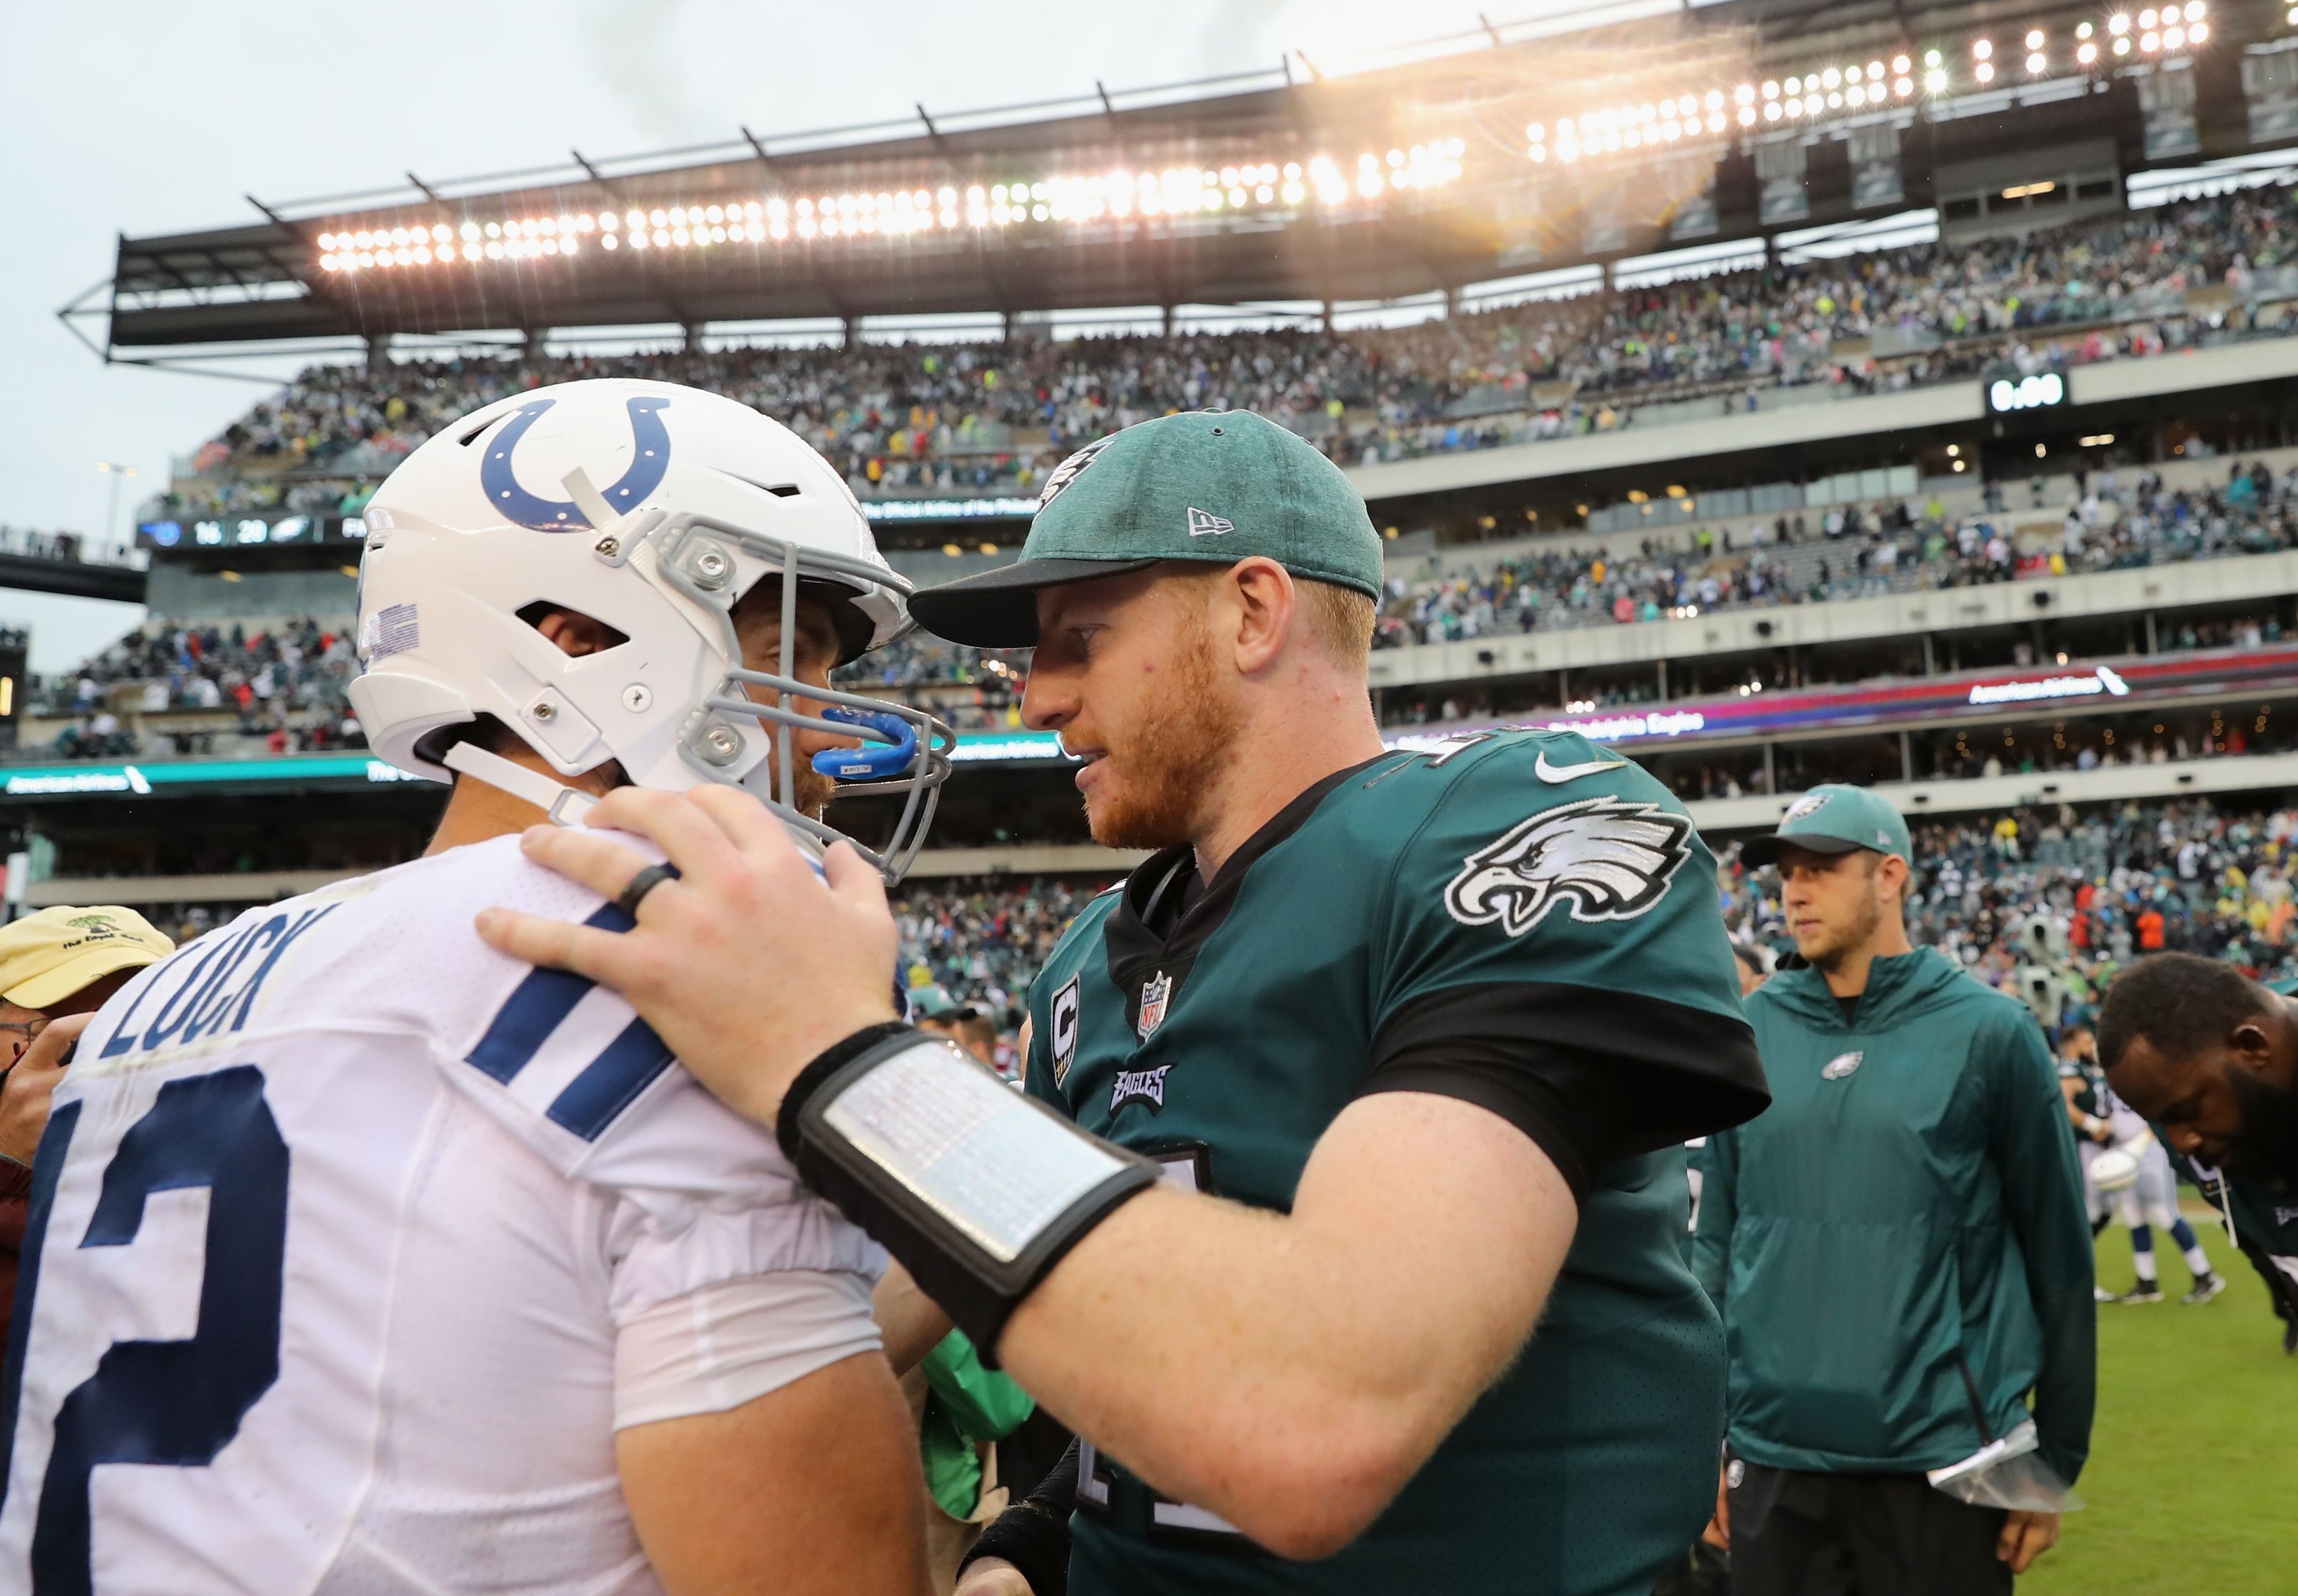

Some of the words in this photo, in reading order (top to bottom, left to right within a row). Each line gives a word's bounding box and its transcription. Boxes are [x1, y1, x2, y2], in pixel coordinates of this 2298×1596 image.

[98, 901, 345, 1059] LUCK
[1054, 984, 1077, 1060] C
[1141, 1004, 1160, 1028] NFL
[1110, 1065, 1172, 1111] EAGLES
